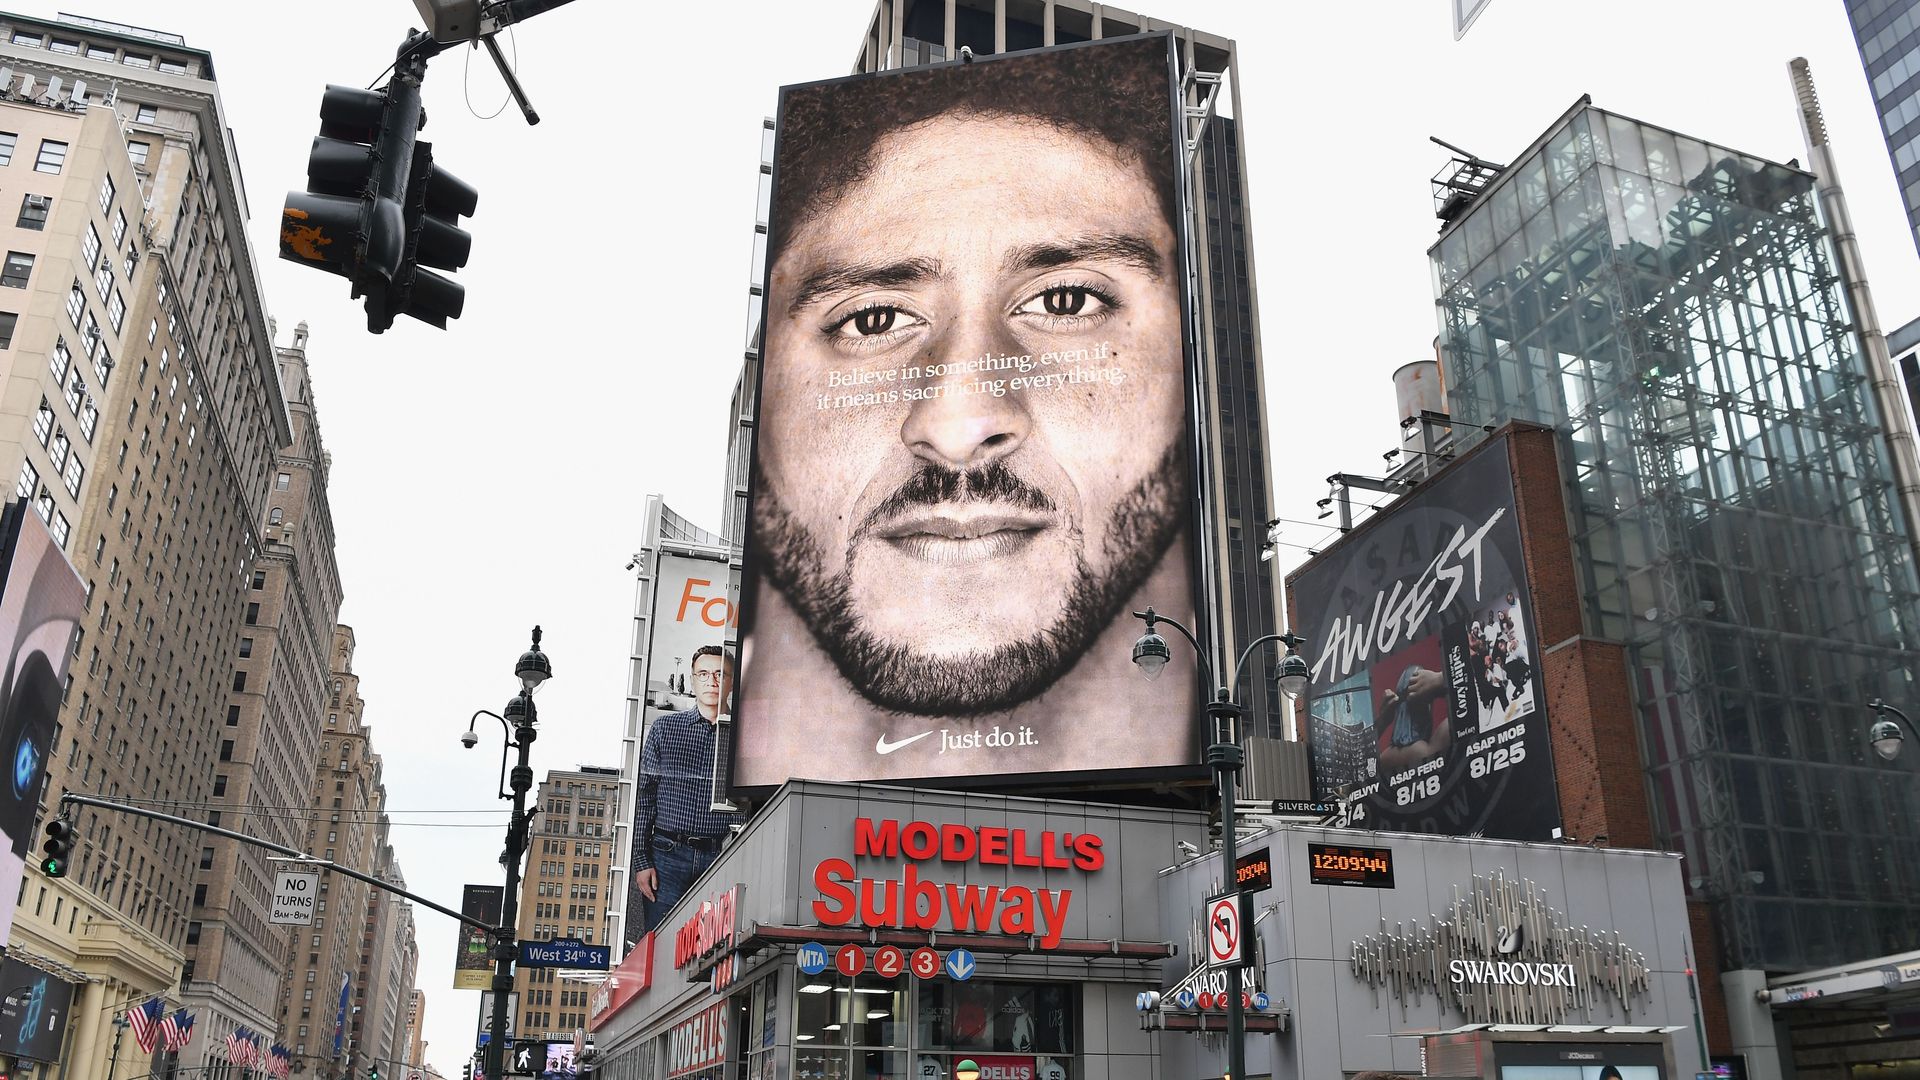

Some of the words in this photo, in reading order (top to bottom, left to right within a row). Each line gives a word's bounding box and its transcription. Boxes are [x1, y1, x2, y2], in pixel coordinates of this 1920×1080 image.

[829, 368, 897, 388] Believe
[901, 363, 921, 379] in
[925, 352, 1038, 379] something,
[1041, 349, 1087, 365] even
[1090, 341, 1110, 361] if
[817, 391, 833, 410] it
[835, 389, 898, 407] means
[902, 377, 1006, 403] sacrificing
[1010, 364, 1127, 391] everything.
[1310, 508, 1506, 685] AWGEST
[938, 729, 982, 754] Just
[985, 726, 1015, 747] do
[1017, 726, 1039, 746] it.
[1497, 723, 1526, 744] MOB
[1417, 756, 1445, 777] FERG
[1470, 740, 1526, 779] 8/25
[1396, 775, 1441, 806] 8/18
[854, 817, 1105, 872] MODELL'S
[1313, 854, 1387, 873] 12:09:44
[285, 879, 307, 891] NO
[276, 895, 312, 907] TURNS
[811, 858, 1073, 950] Subway
[529, 947, 560, 961] West
[563, 949, 587, 962] 34th
[589, 951, 602, 964] St
[798, 948, 825, 967] MTA
[882, 952, 897, 972] 2
[917, 953, 933, 972] 3
[1185, 966, 1255, 995] WAROKI
[1449, 959, 1577, 988] SWAROVSKI
[923, 1066, 936, 1076] 27
[980, 1066, 1031, 1080] DELL'S
